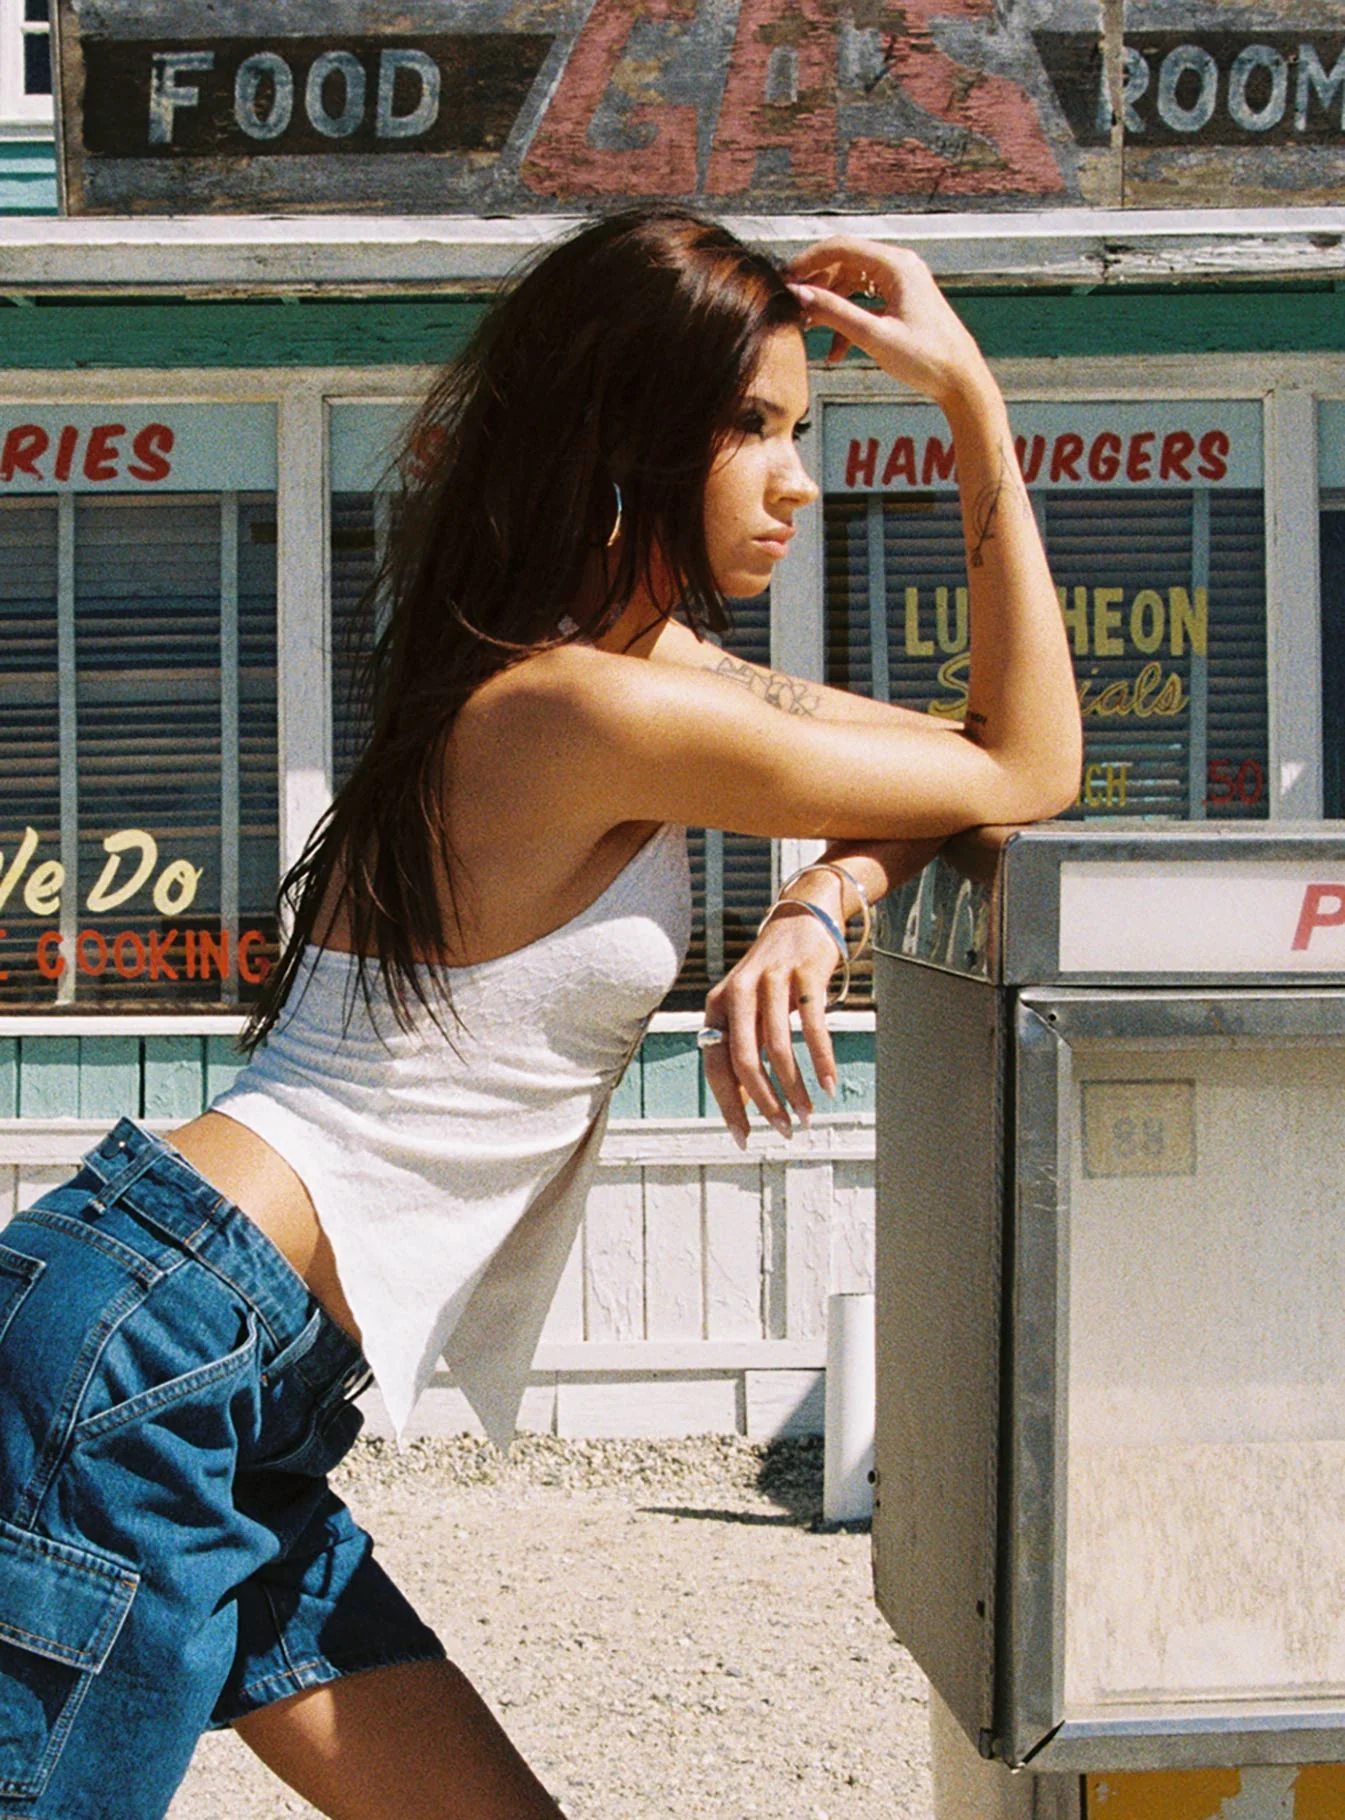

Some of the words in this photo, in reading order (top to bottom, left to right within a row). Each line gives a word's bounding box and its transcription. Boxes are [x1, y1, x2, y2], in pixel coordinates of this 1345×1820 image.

[149, 48, 441, 144] FOOD
[1095, 43, 1345, 132] ROOM
[0, 423, 174, 481] RIES
[845, 430, 1230, 488] HAMURGERS
[905, 586, 1208, 656] LUHEON
[928, 652, 1190, 720] Sials
[86, 829, 203, 916] Do
[37, 929, 270, 983] COOKING
